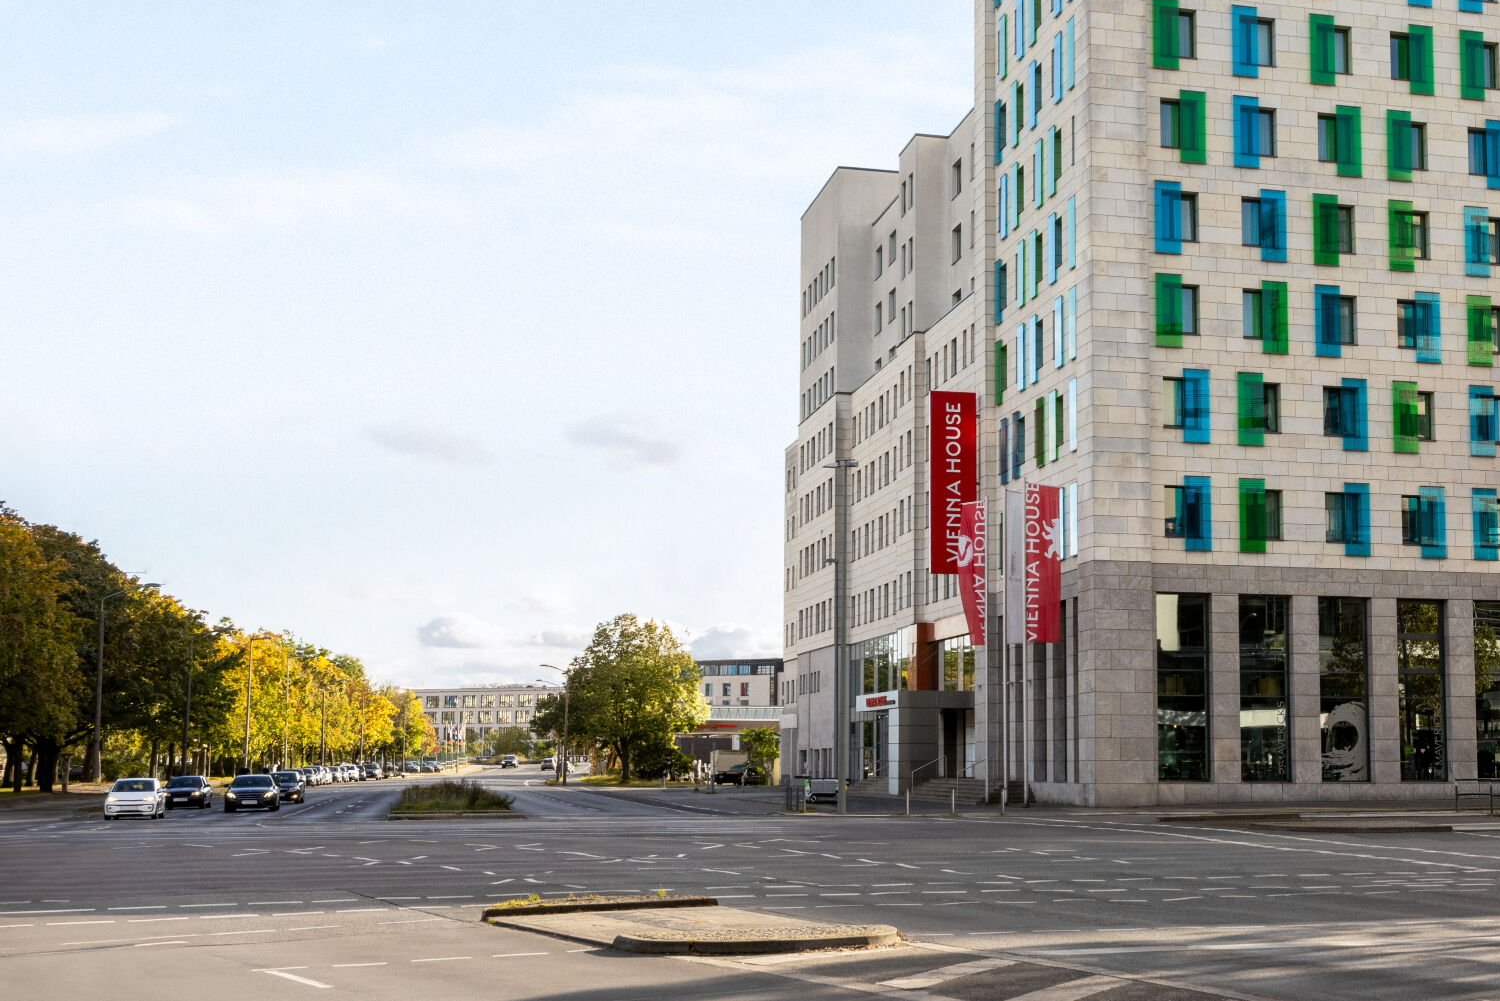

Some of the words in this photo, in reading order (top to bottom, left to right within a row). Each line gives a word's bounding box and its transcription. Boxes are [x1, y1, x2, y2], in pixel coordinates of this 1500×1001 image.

[945, 402, 962, 474] HOUSE
[945, 479, 962, 563] VIENNA
[1025, 481, 1041, 554] HOUSE
[1025, 560, 1040, 642] VIENNA
